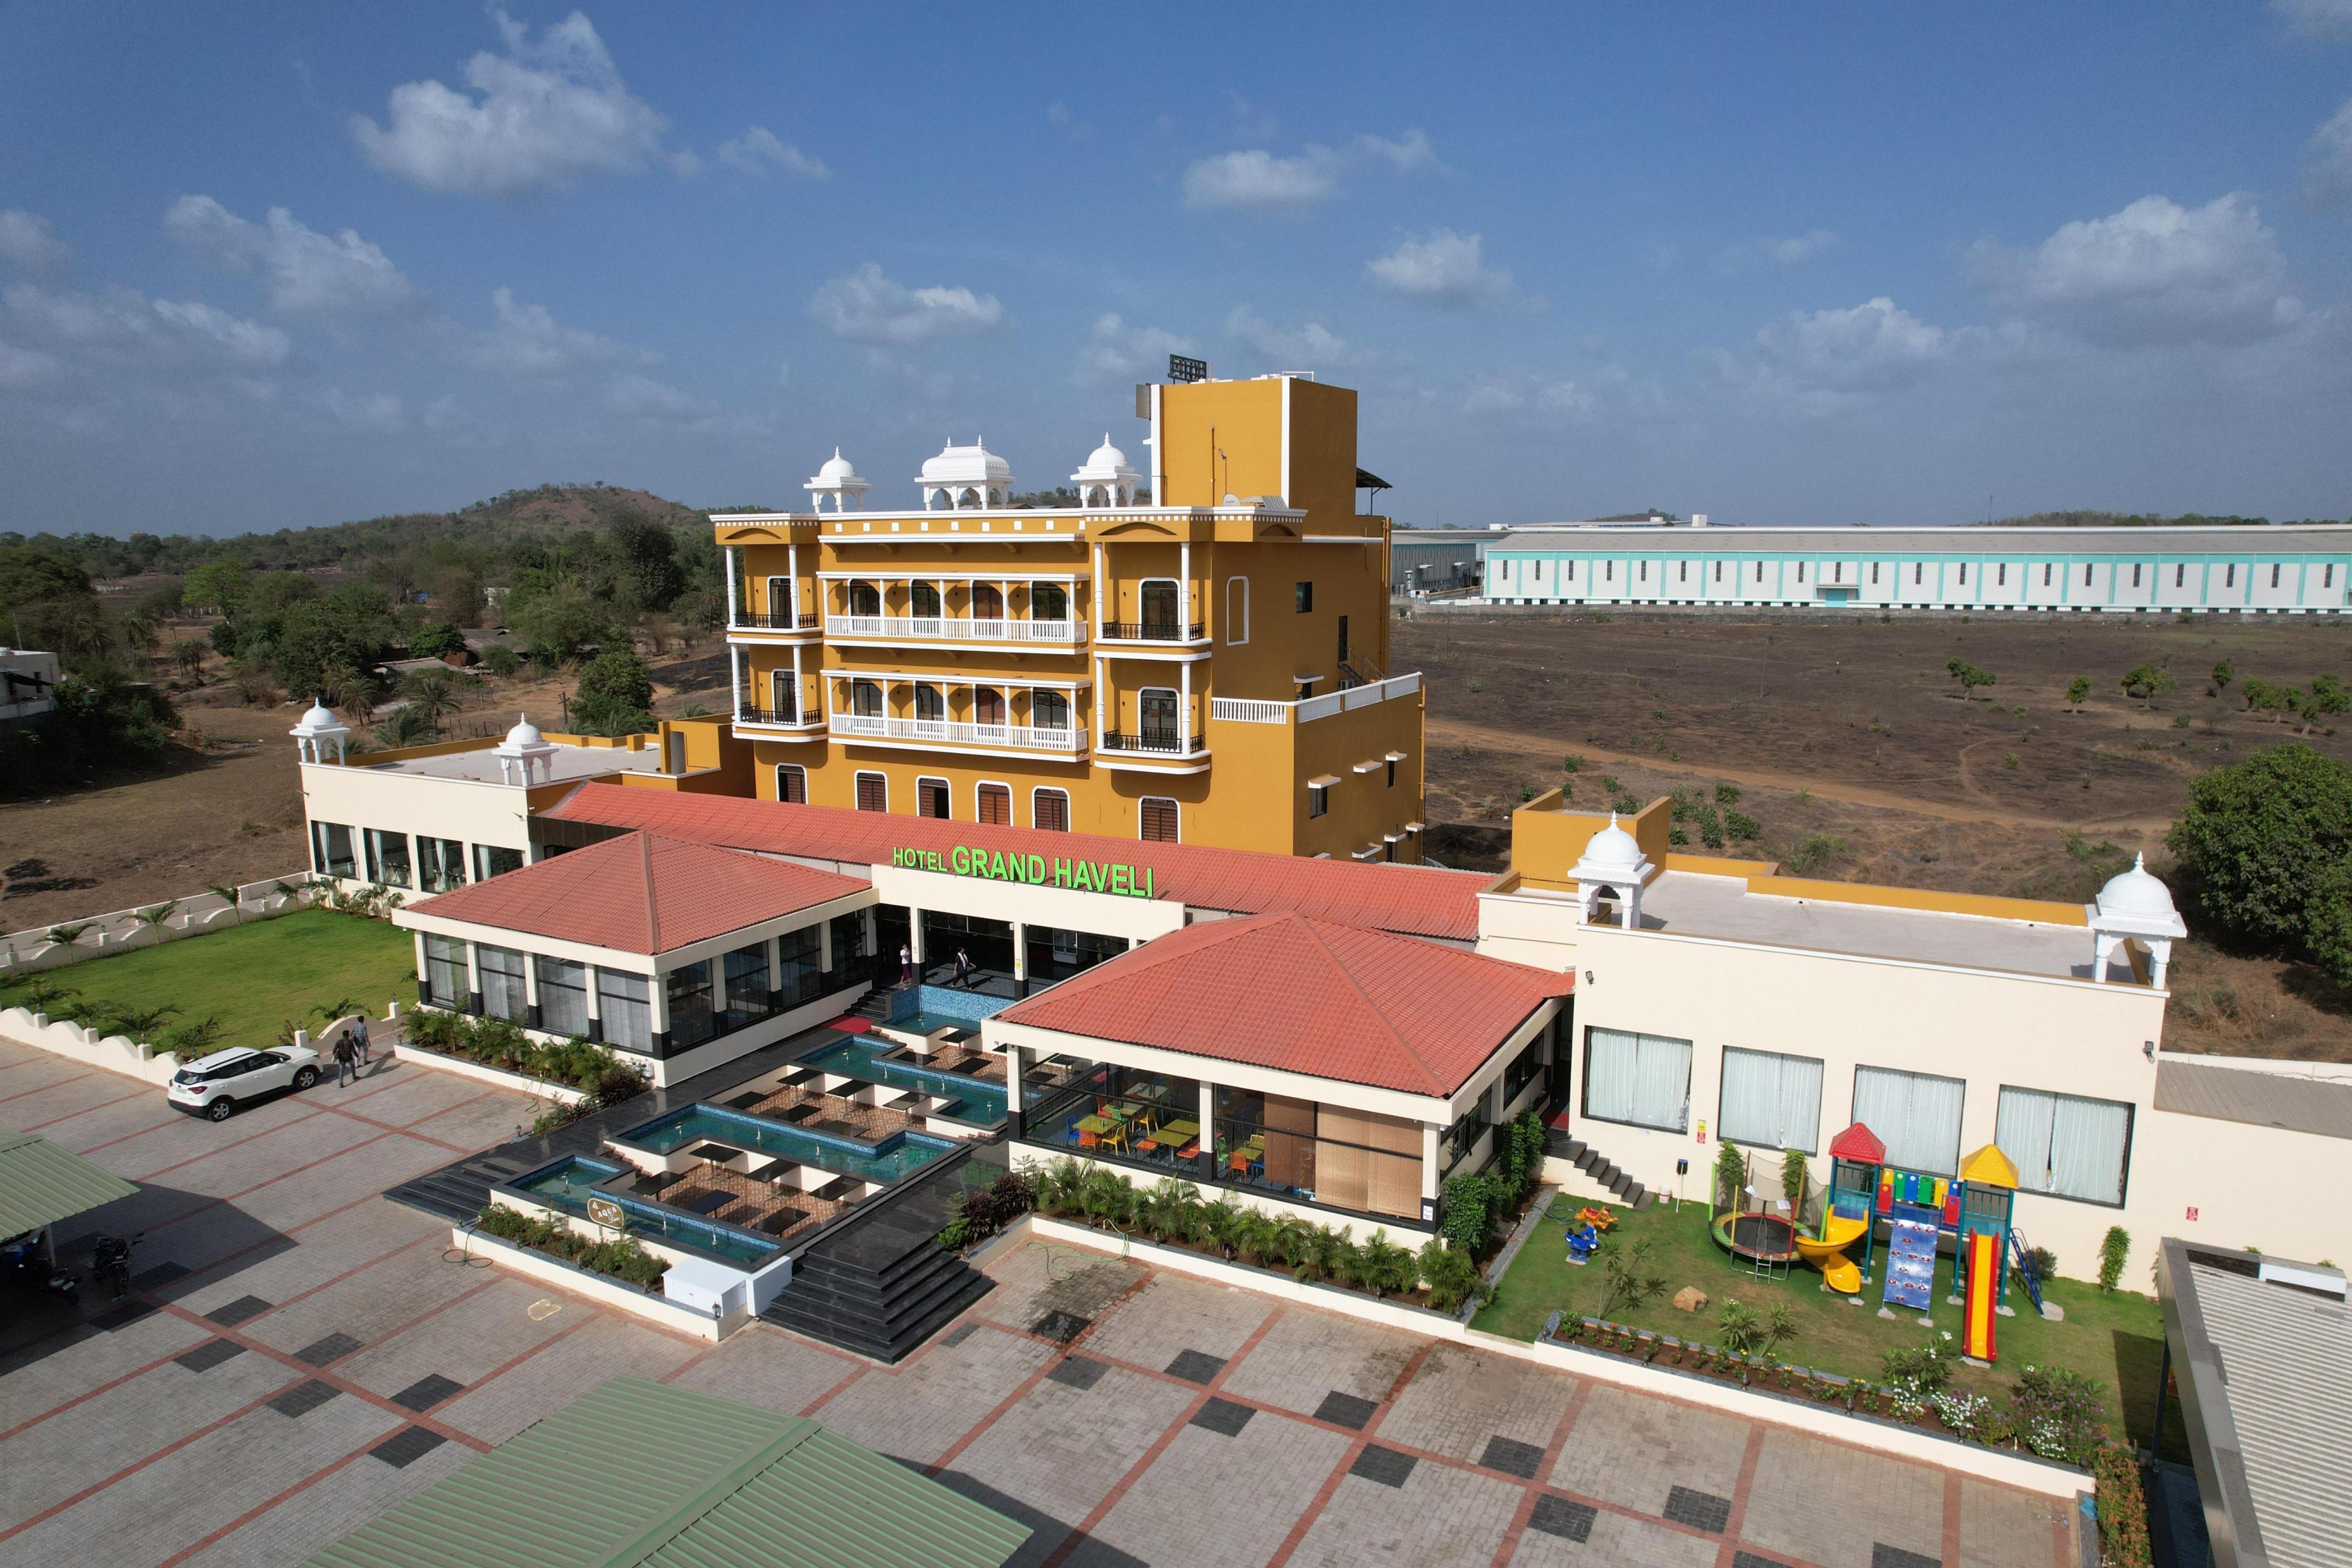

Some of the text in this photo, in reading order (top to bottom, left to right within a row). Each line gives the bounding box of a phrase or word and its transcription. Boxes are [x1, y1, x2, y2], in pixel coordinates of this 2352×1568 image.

[893, 846, 1153, 897] HOTEL GRAND HAVELI
[598, 1206, 617, 1218] AQUA
